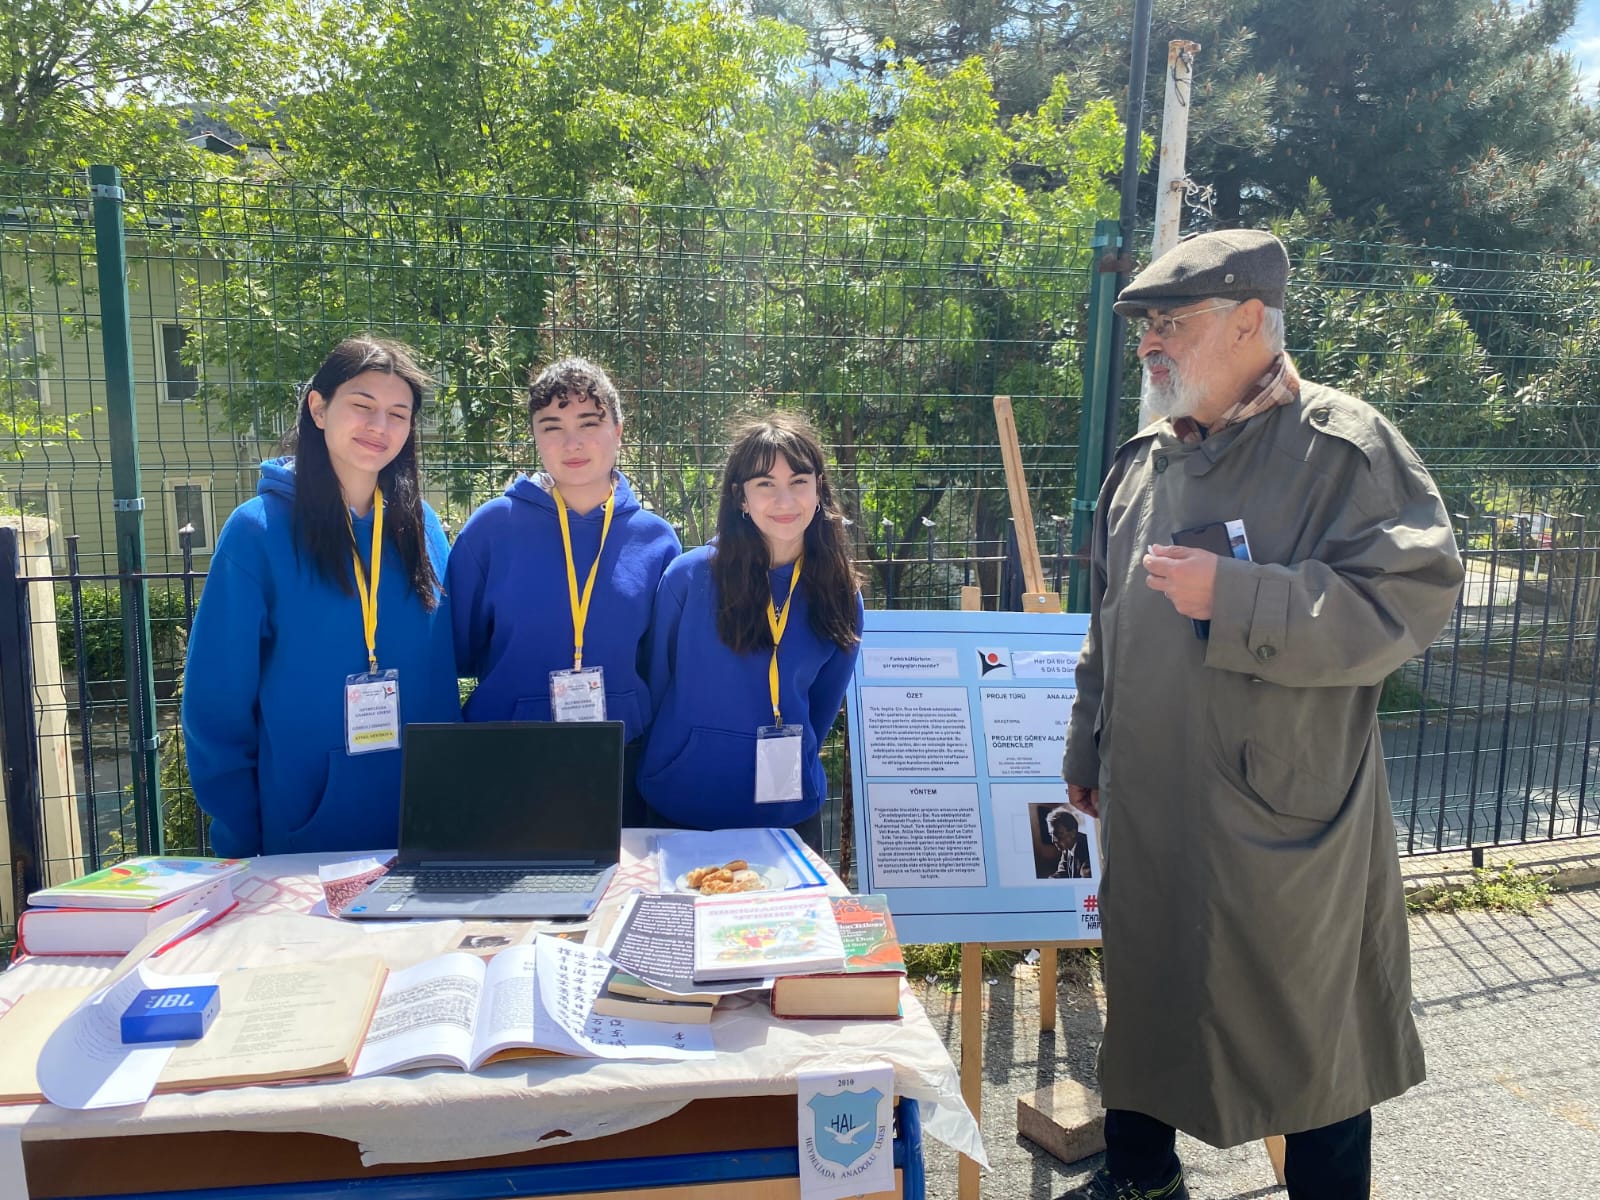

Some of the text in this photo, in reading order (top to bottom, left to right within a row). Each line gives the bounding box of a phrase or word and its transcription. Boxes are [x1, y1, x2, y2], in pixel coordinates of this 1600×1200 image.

[145, 993, 194, 1008] JBL
[831, 1114, 856, 1133] HAL
[841, 1155, 877, 1179] ANADOLU
